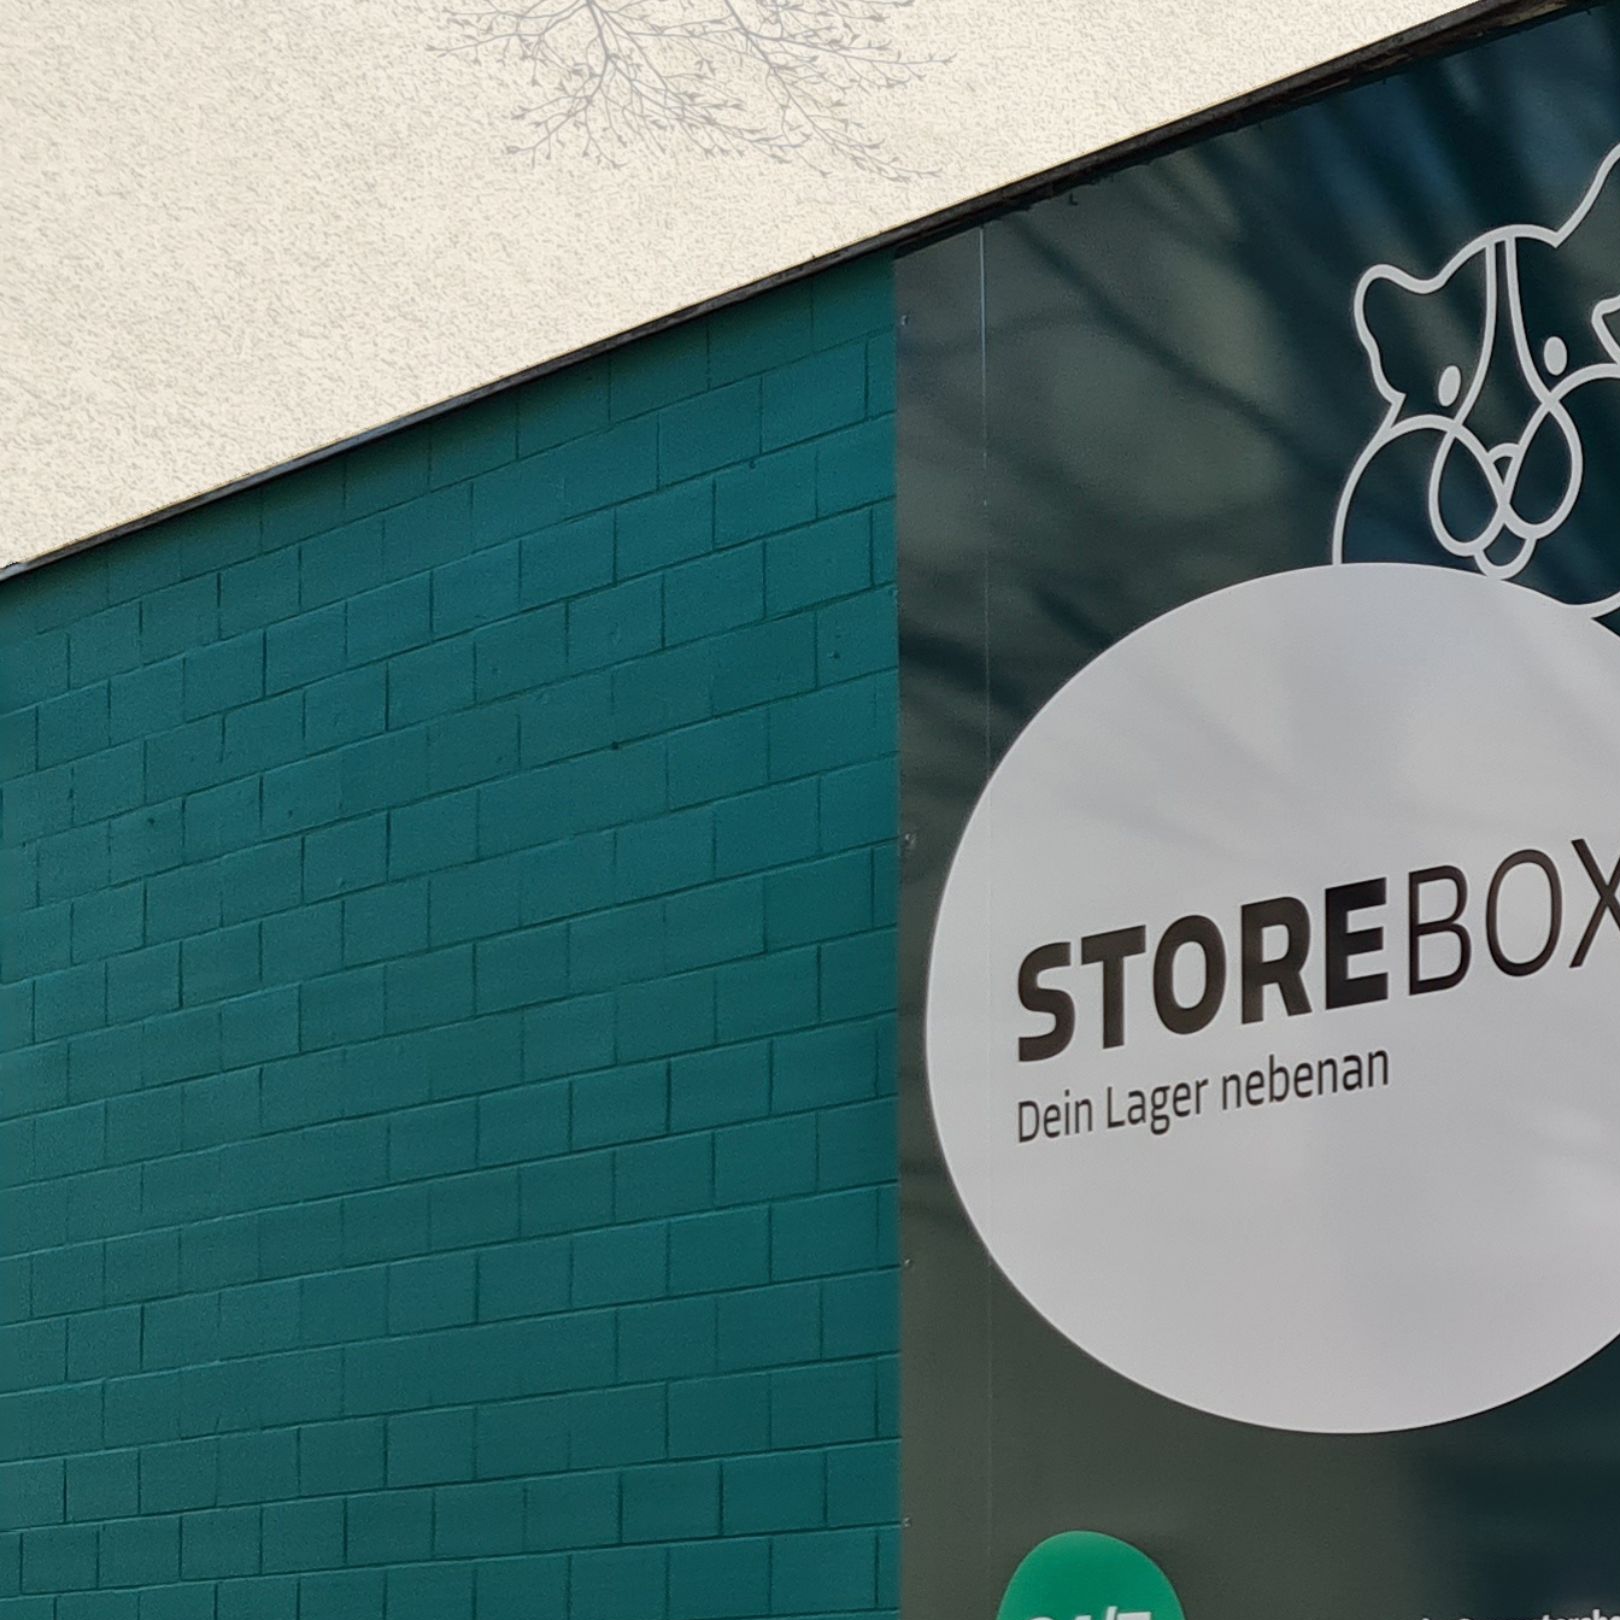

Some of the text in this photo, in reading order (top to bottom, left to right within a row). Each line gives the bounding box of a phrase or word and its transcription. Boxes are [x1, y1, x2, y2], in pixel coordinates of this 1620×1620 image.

[1018, 1049, 1389, 1142] Dein Lager nebenan
